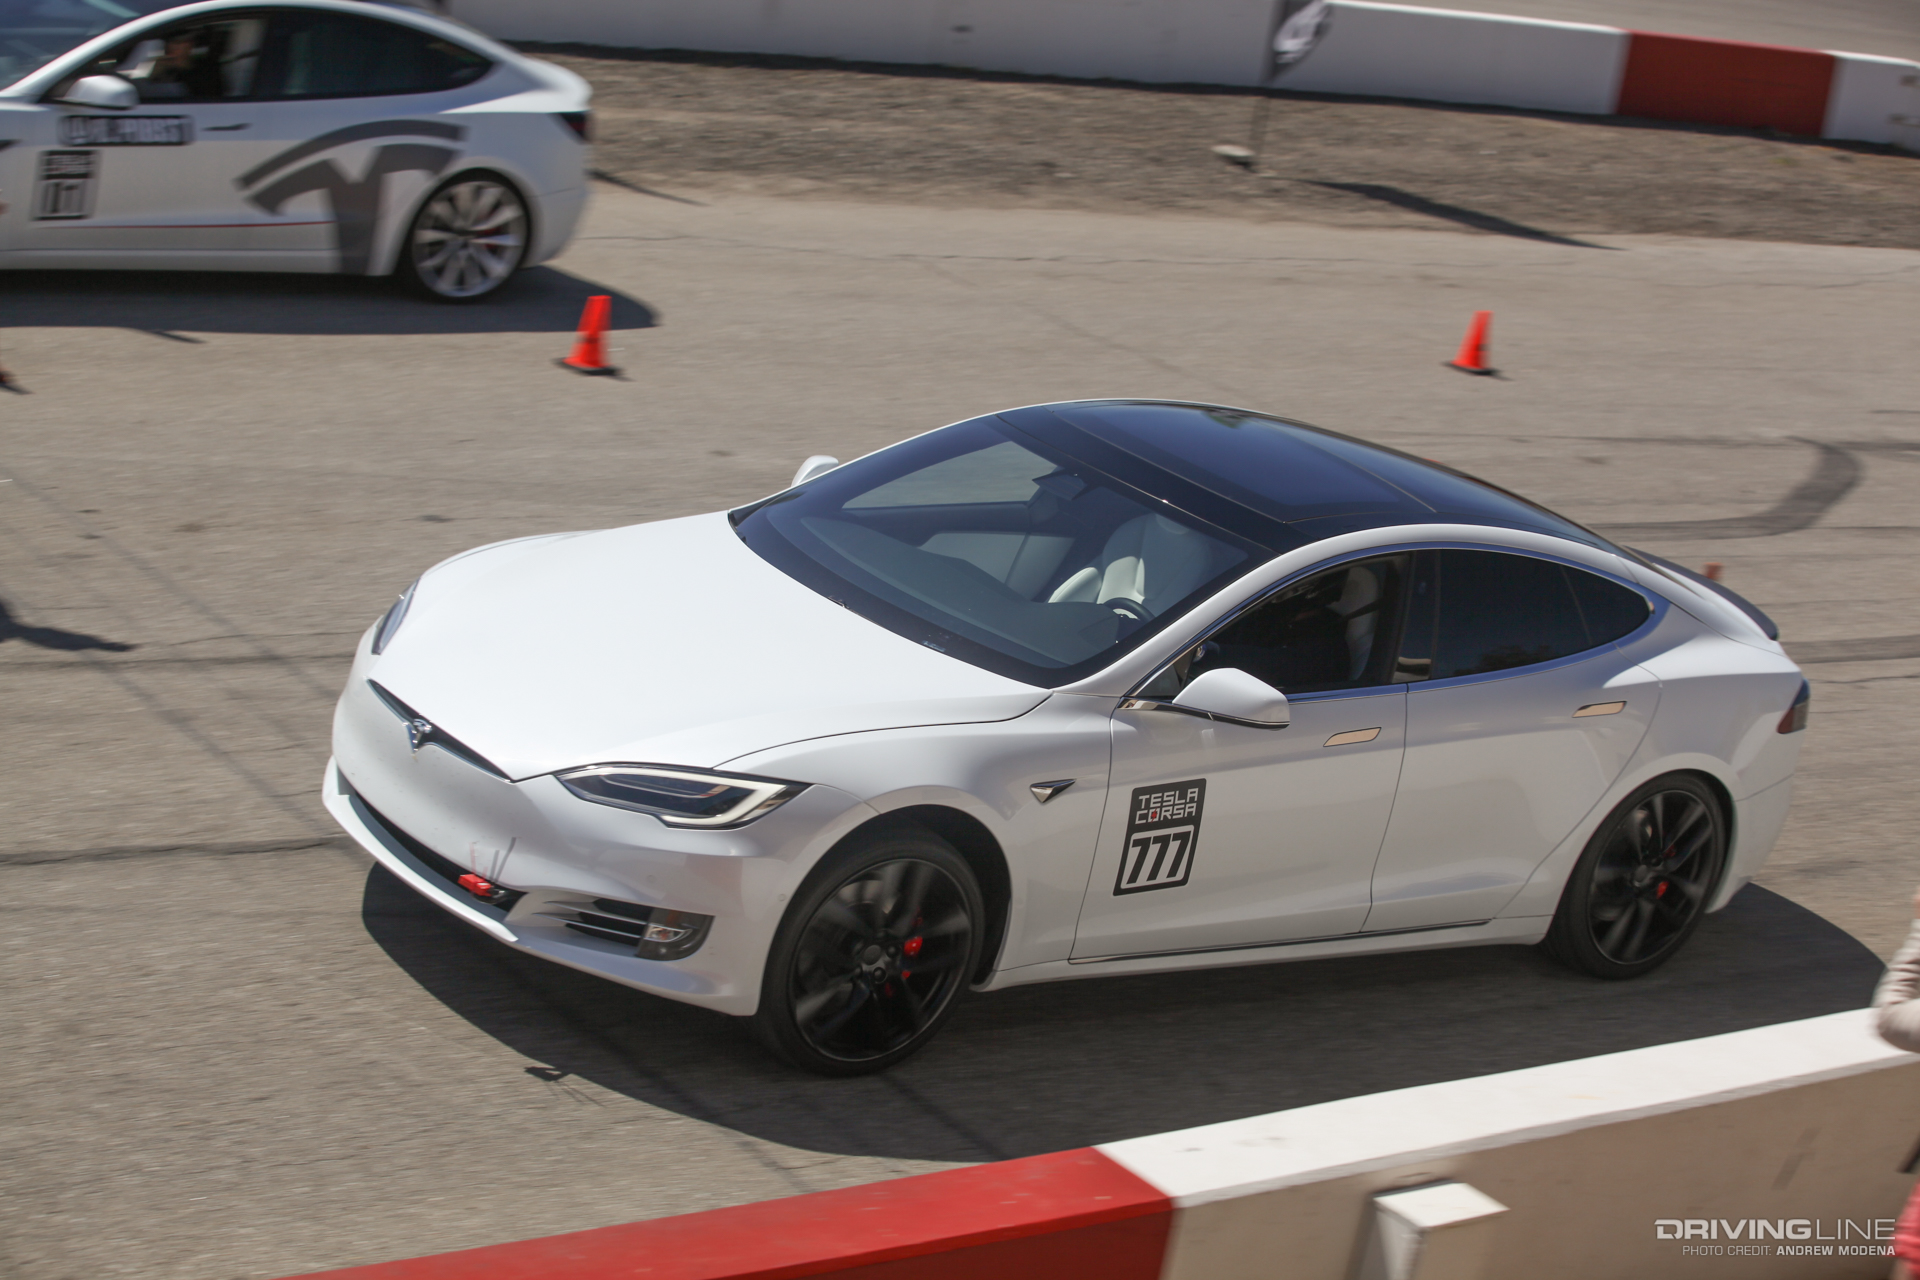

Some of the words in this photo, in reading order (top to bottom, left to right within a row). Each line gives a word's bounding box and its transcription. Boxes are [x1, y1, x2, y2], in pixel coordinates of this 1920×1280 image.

[1138, 787, 1199, 809] TESLA
[1135, 802, 1197, 825] CORSA
[1126, 830, 1192, 885] 777
